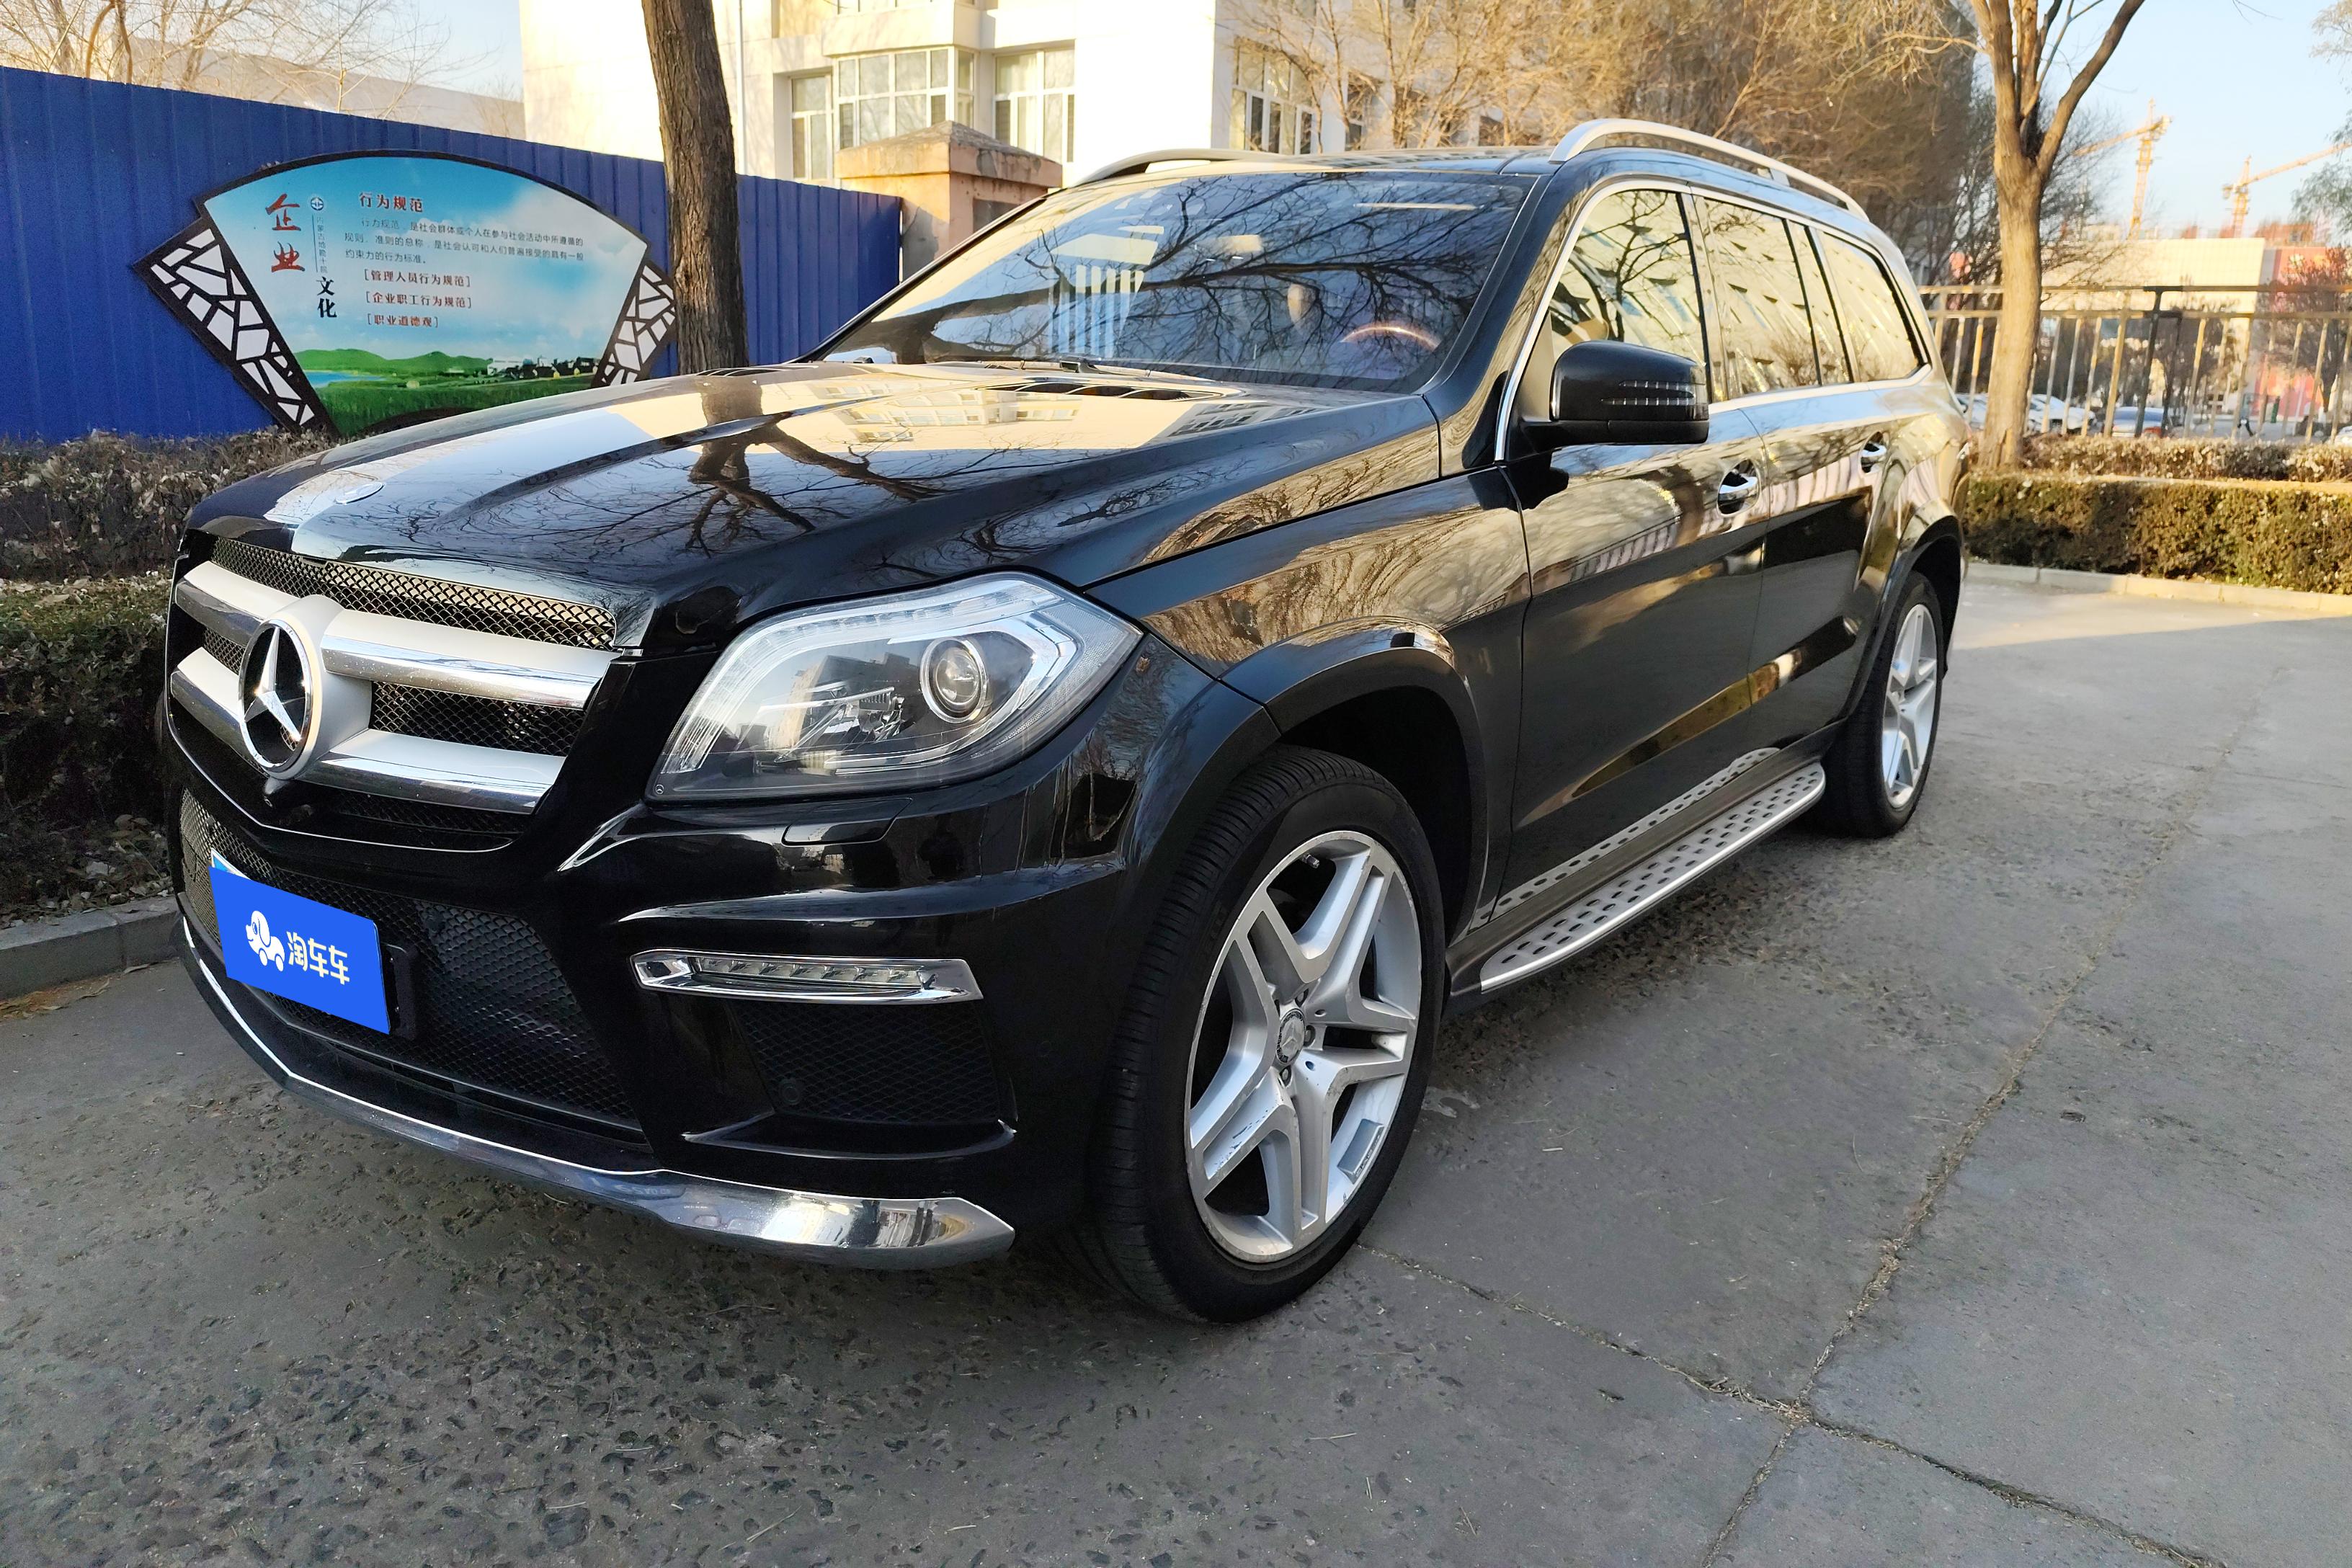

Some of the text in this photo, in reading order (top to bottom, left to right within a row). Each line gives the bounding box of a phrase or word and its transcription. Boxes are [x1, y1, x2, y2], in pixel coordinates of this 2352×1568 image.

[359, 192, 424, 213] 行为规范
[316, 276, 337, 318] 文化
